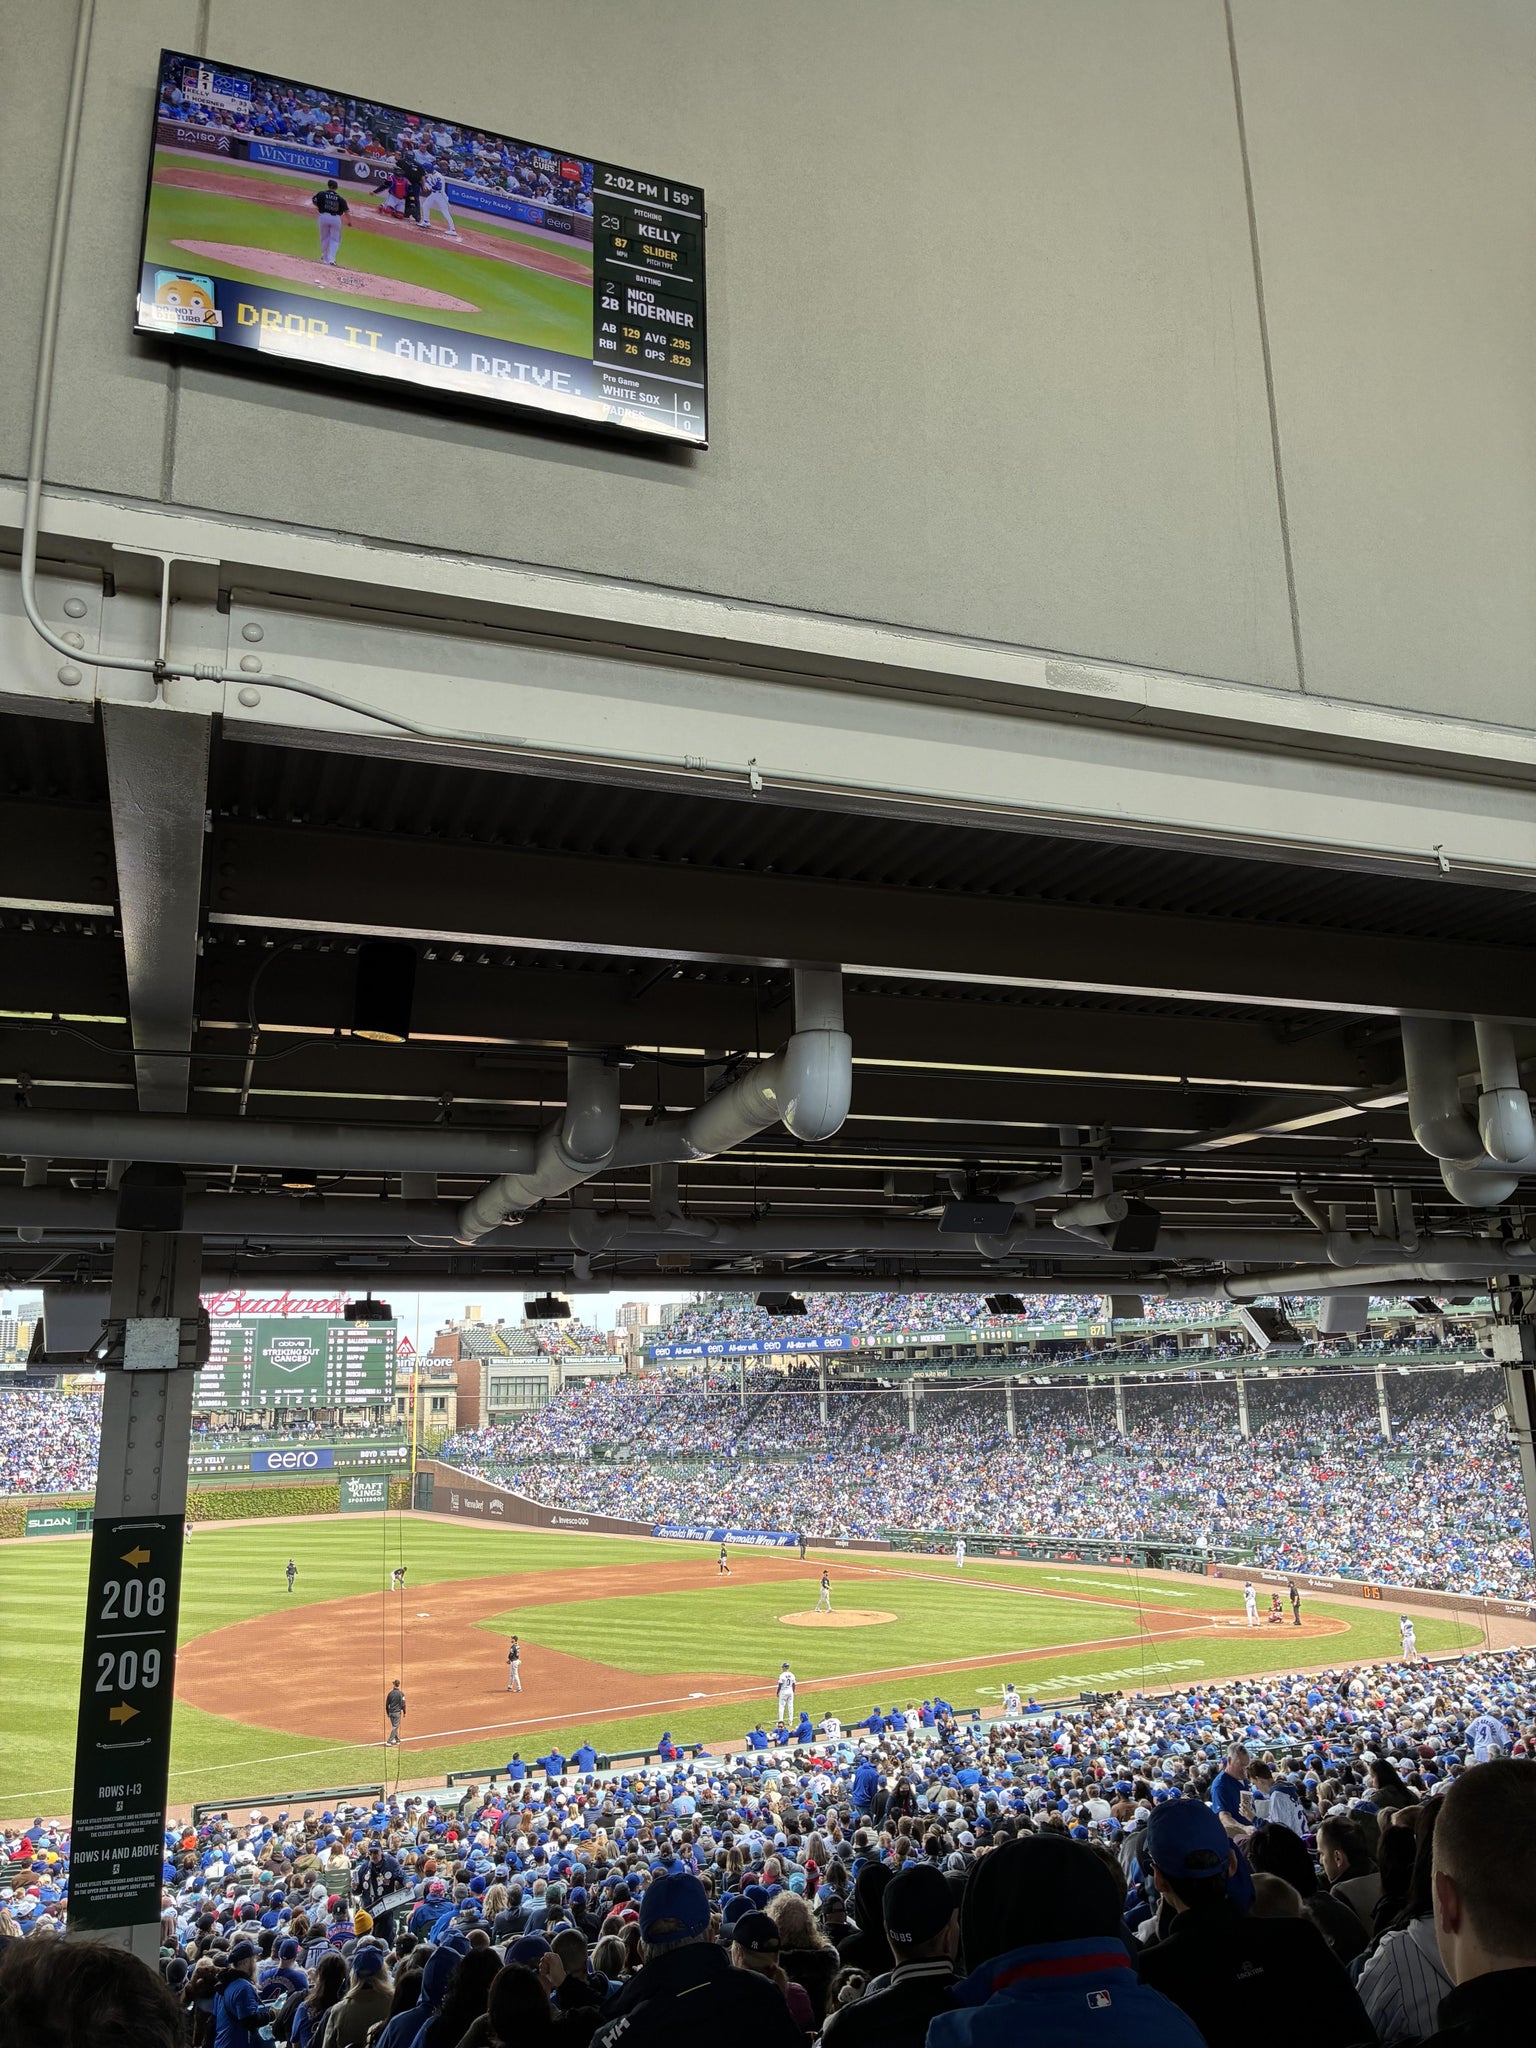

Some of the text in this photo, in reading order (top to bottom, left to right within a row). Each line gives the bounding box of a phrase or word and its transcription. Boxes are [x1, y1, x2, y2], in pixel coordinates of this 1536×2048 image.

[186, 87, 210, 97] KELLY
[177, 129, 215, 142] DAISO
[259, 144, 331, 171] WINTRUST
[604, 173, 635, 191] 2:02
[637, 182, 658, 198] PM
[634, 209, 662, 221] PITCHING
[638, 224, 681, 245] KELLY
[614, 237, 678, 261] 87 SLIDER
[616, 250, 673, 270] MPH PITCH TYPE
[635, 275, 662, 287] BATTING
[606, 282, 655, 304] 2 NICO
[174, 307, 194, 316] NOT
[601, 296, 694, 329] 2B HOERNER
[602, 322, 691, 351] AB 129 AVG .295
[237, 303, 582, 395] DROP IT AND DRIVE.
[599, 338, 692, 367] RBI 26 OPS .829
[603, 373, 640, 388] Pre Game
[602, 384, 691, 412] WHITE SOX 0
[683, 420, 691, 431] 0
[303, 1348, 320, 1356] OUT
[655, 1347, 671, 1356] eero
[707, 1344, 724, 1353] eero
[763, 1341, 781, 1350] eero
[823, 1338, 843, 1347] eero
[416, 1357, 452, 1367] Moore
[204, 1456, 226, 1465] KELLY
[267, 1452, 318, 1469] eero
[348, 1482, 383, 1493] DRAFT
[352, 1489, 382, 1498] KINGS
[558, 1515, 577, 1525] Invesco
[658, 1528, 704, 1539] Reynolds Wrap
[723, 1532, 776, 1546] Reynolds Wrap
[101, 1577, 166, 1619] 208
[95, 1648, 161, 1692] 209
[975, 1661, 1188, 1698] Southwest
[827, 1723, 837, 1733] 27
[1479, 1726, 1487, 1740] 4
[98, 1783, 142, 1798] ROWS 1-13
[73, 1844, 160, 1864] ROWS 14 AND ABOVE
